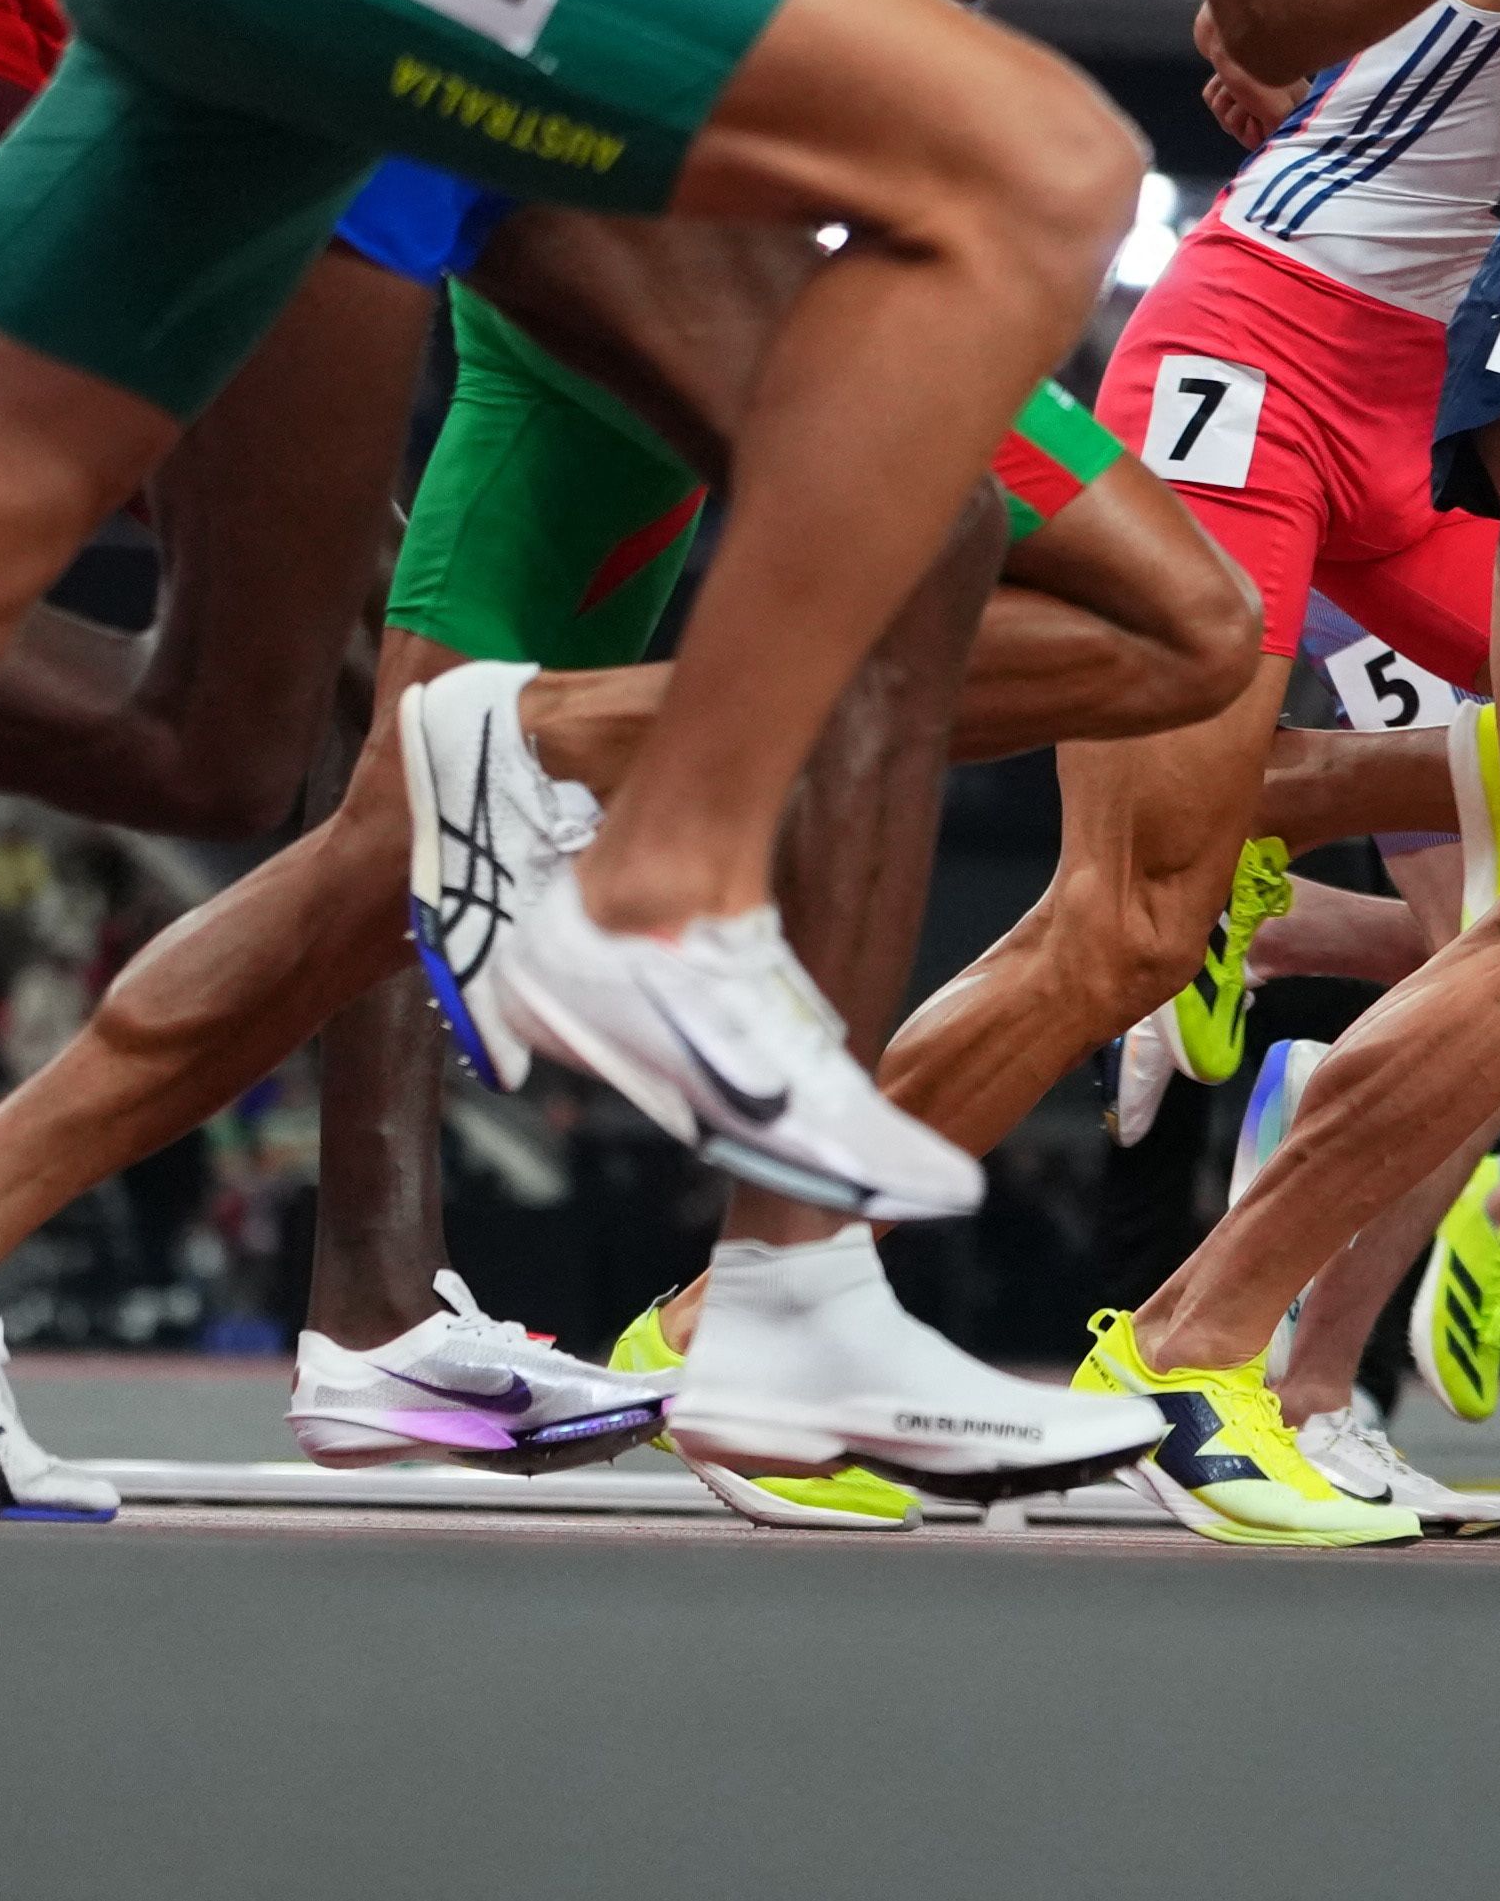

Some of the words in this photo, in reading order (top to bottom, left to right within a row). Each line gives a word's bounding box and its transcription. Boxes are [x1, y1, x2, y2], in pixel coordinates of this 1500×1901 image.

[388, 55, 626, 174] AUSTRALIA
[1168, 377, 1232, 461] 7
[1364, 650, 1420, 728] 5
